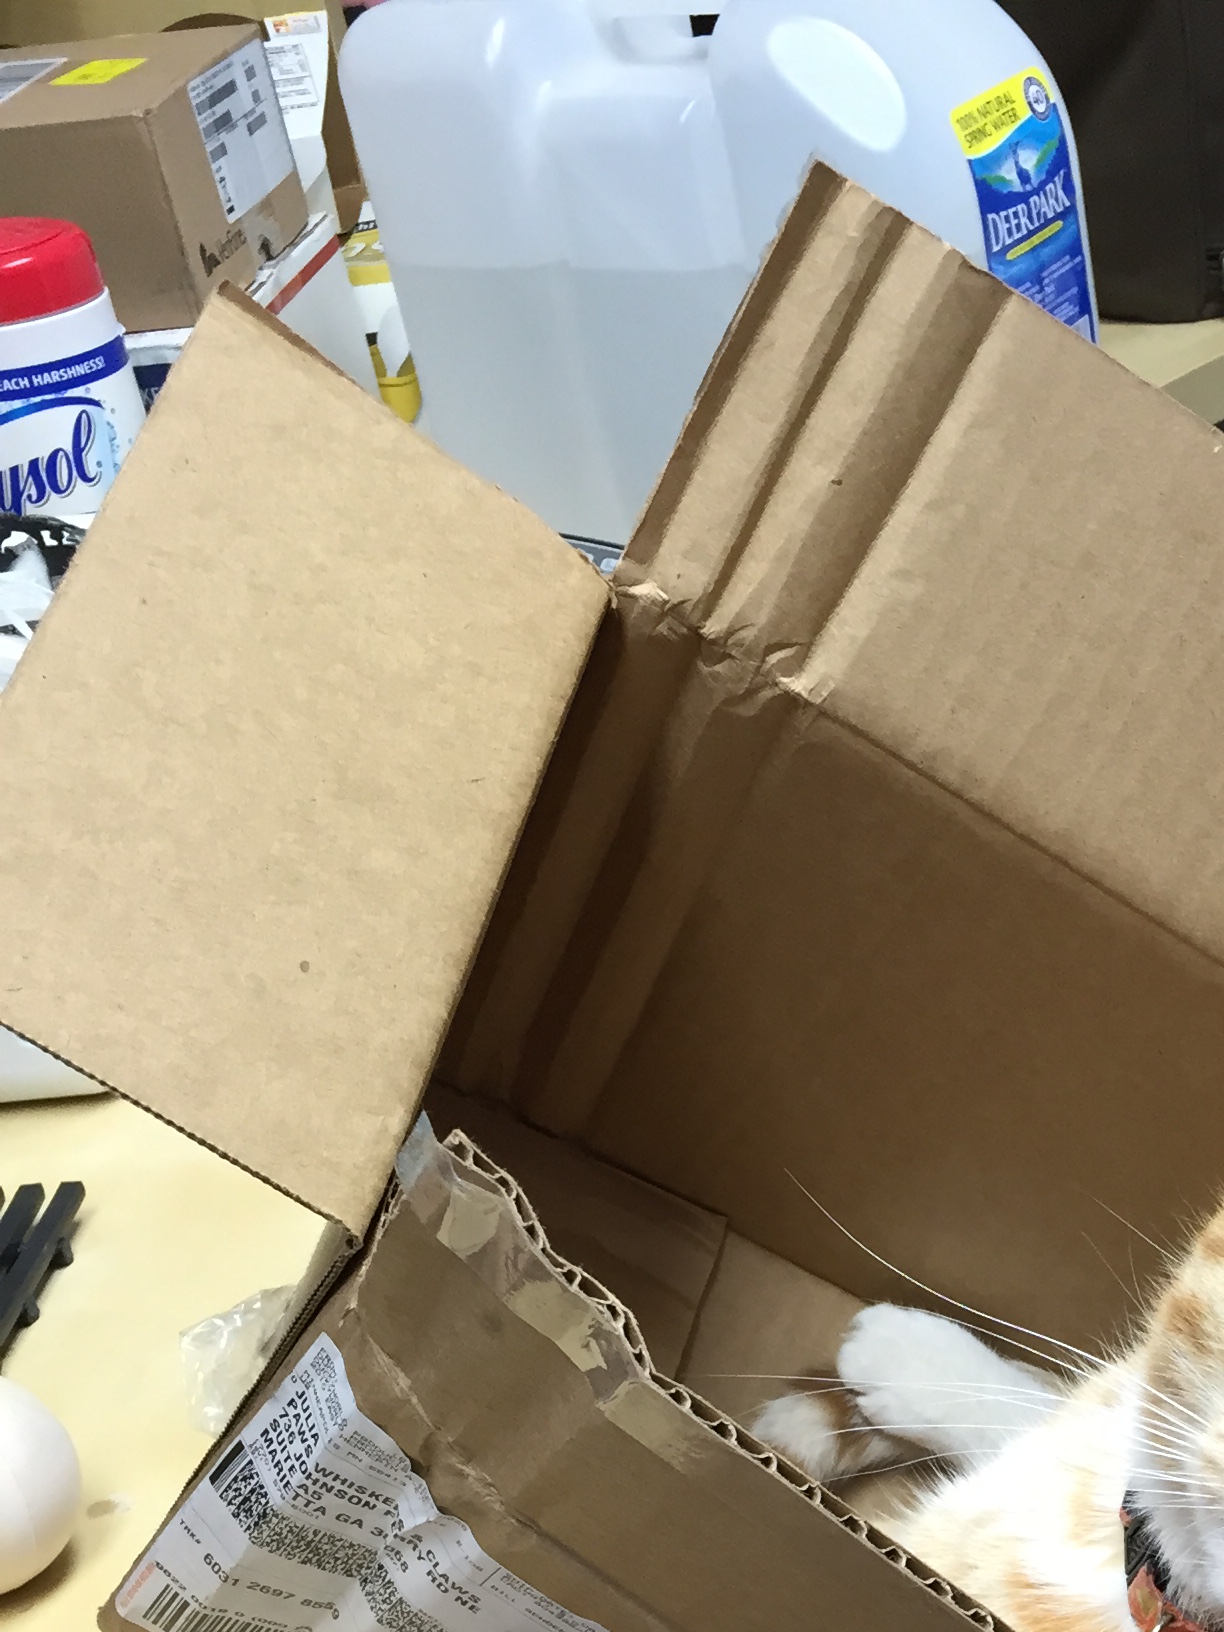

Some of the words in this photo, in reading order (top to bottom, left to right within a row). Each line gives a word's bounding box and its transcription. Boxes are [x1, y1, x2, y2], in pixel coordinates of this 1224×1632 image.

[964, 123, 992, 149] SPRING
[991, 107, 1021, 133] WATER
[976, 90, 1016, 119] NATURAL
[987, 203, 1031, 253] DEER
[1030, 169, 1071, 228] PARK
[0, 376, 30, 392] EACH
[33, 355, 106, 387] HARSHNESS!
[0, 409, 101, 517] ysol
[269, 1418, 298, 1479] SUITE
[296, 1483, 326, 1502] A5
[295, 1389, 321, 1447] JULIA
[259, 1427, 328, 1517] MARIETTA
[334, 1512, 364, 1530] GA
[278, 1406, 297, 1445] 736
[294, 1452, 378, 1512] JOHNSON
[453, 1595, 483, 1615] NE
[286, 1398, 314, 1459] PAWS
[425, 1549, 482, 1604] CLAWS
[203, 1552, 240, 1587] 6031
[246, 1581, 296, 1600] 2697
